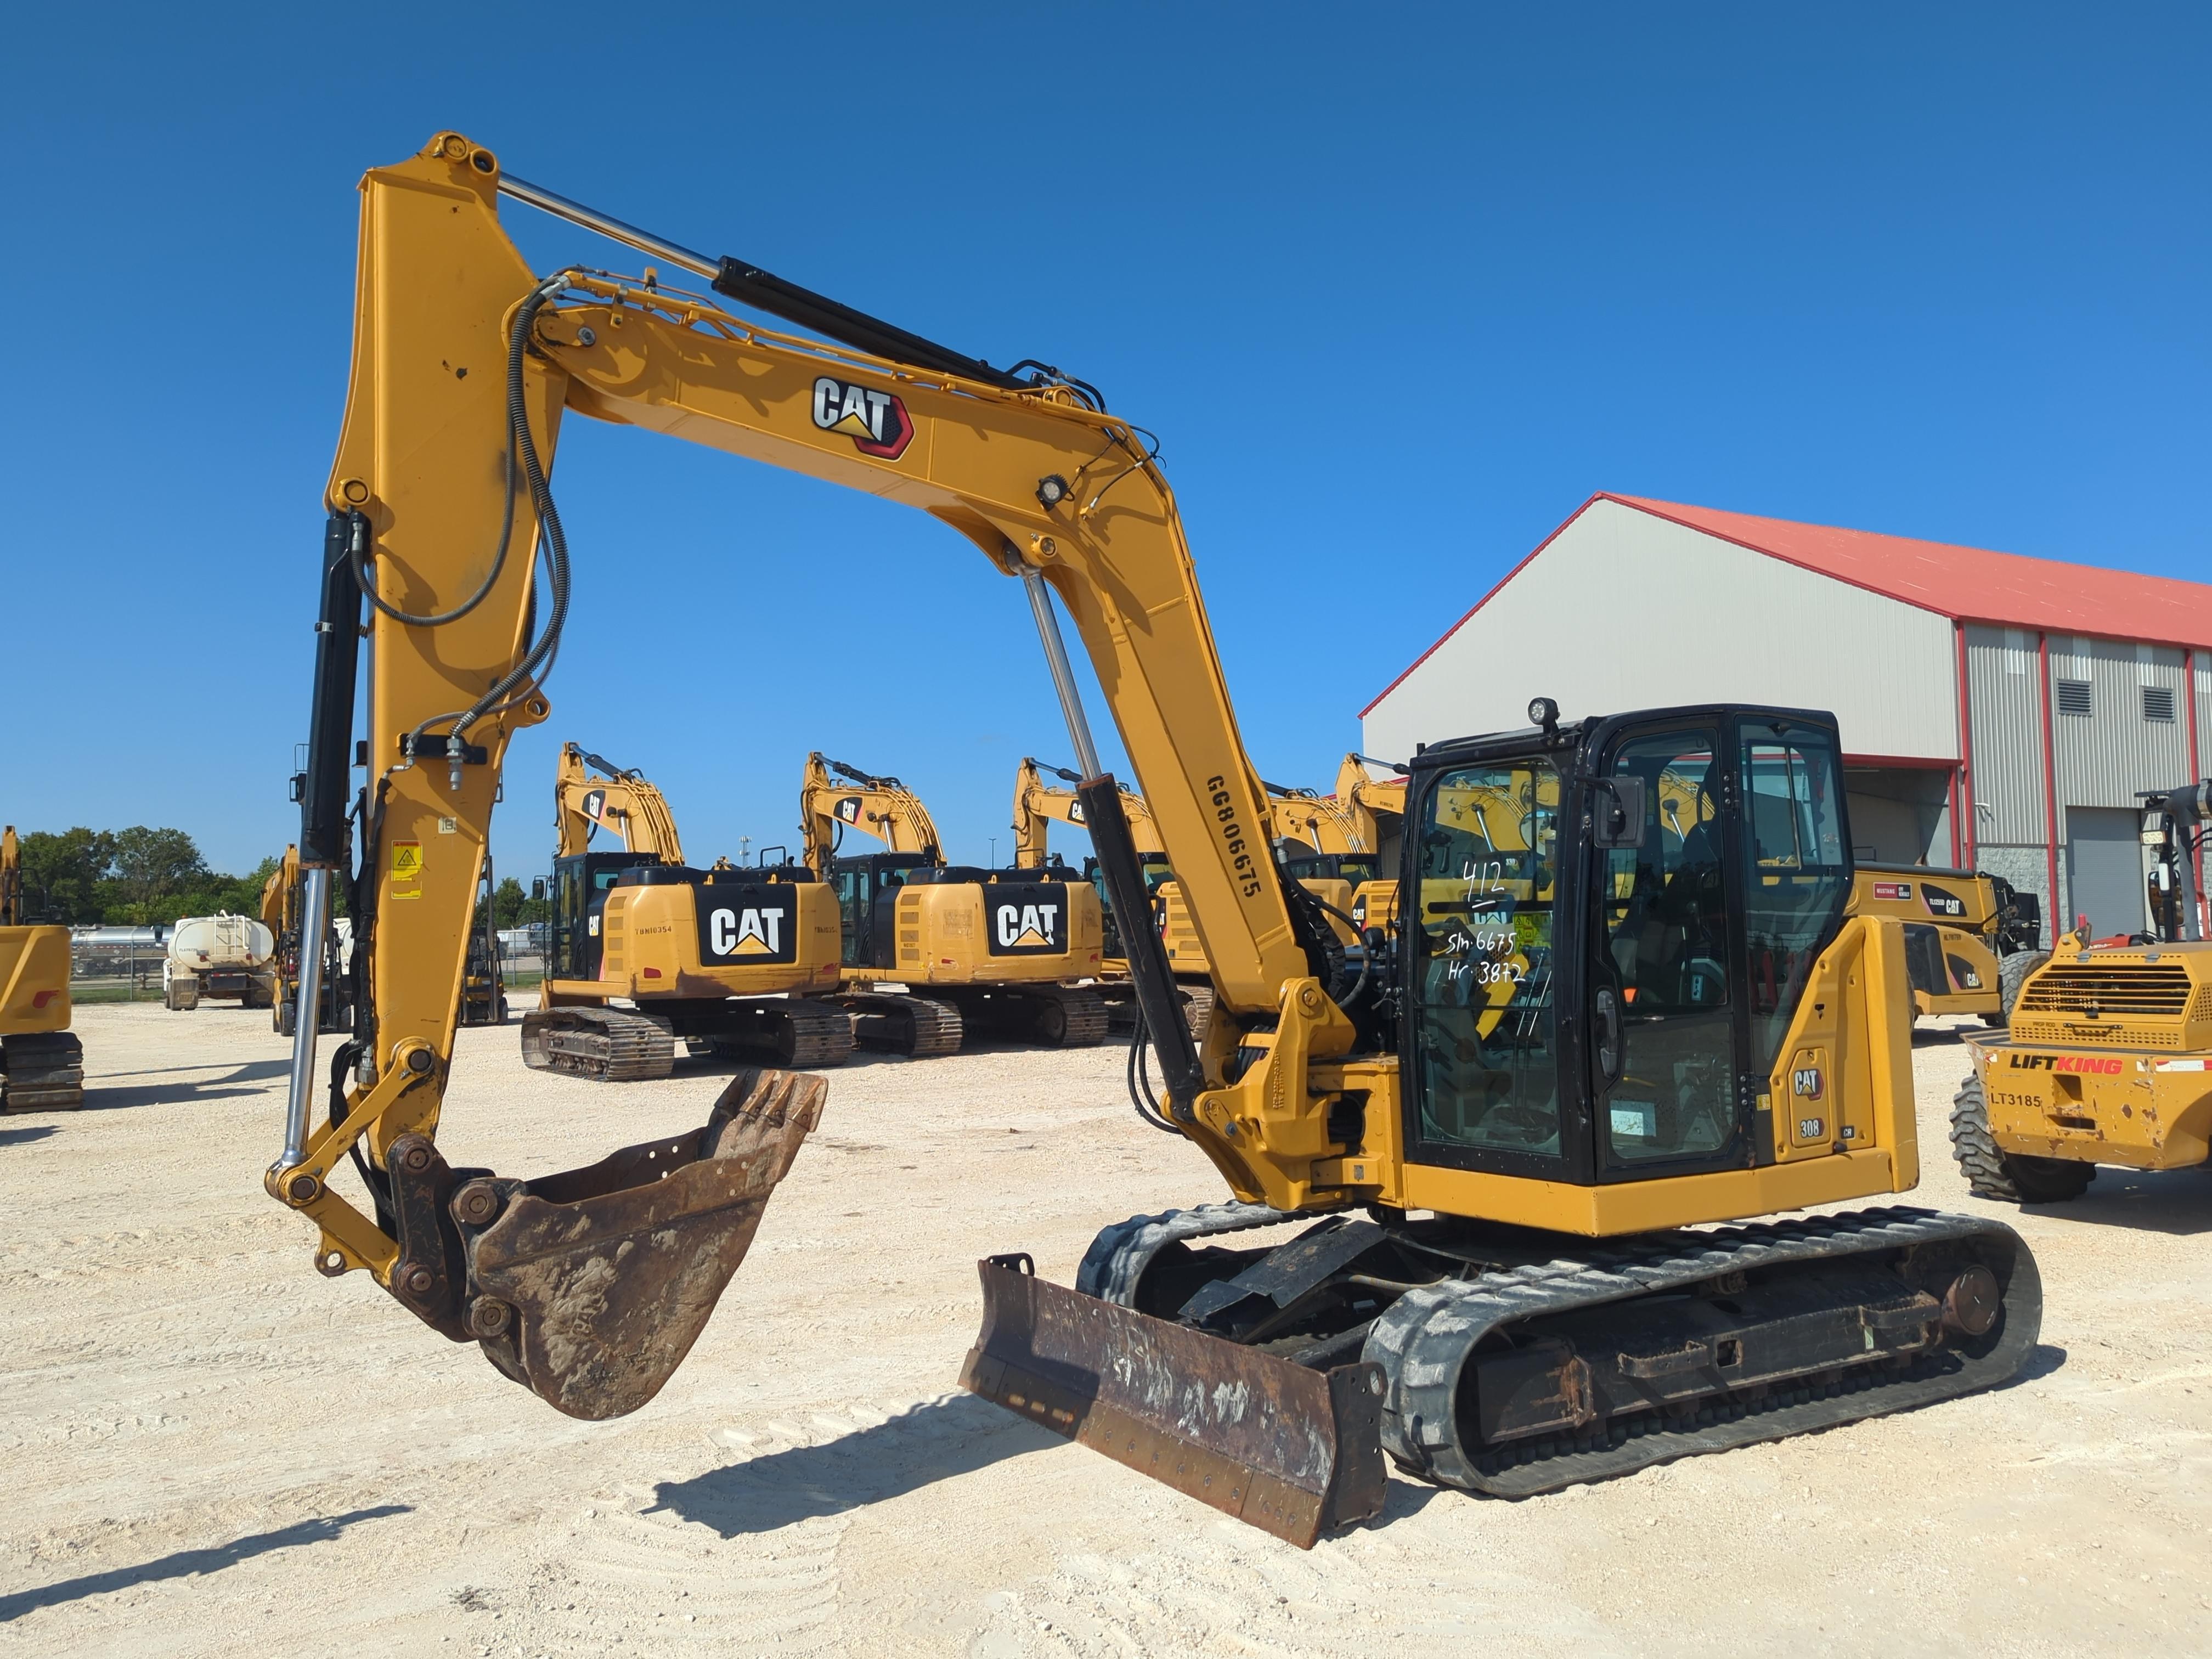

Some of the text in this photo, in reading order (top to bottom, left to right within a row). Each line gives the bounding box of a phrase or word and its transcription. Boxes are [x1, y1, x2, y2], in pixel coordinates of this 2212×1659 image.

[814, 377, 891, 441] CAT
[590, 794, 600, 817] CAT
[843, 800, 855, 822] CAT
[1207, 775, 1261, 897] GG806675
[1463, 861, 1505, 902] 412
[1353, 909, 1365, 920] CAT
[1946, 899, 1960, 914] CAT
[589, 915, 600, 936] CAT
[711, 908, 784, 955] CAT
[997, 905, 1058, 946] CAT
[1476, 931, 1517, 955] 6675
[1478, 961, 1526, 984] 3872
[2010, 1054, 2124, 1075] LIFTKING
[1795, 1070, 1817, 1095] CAT
[1991, 1092, 2041, 1107] LT3185
[1801, 1119, 1819, 1138] 308
[1843, 1128, 1852, 1137] CR
